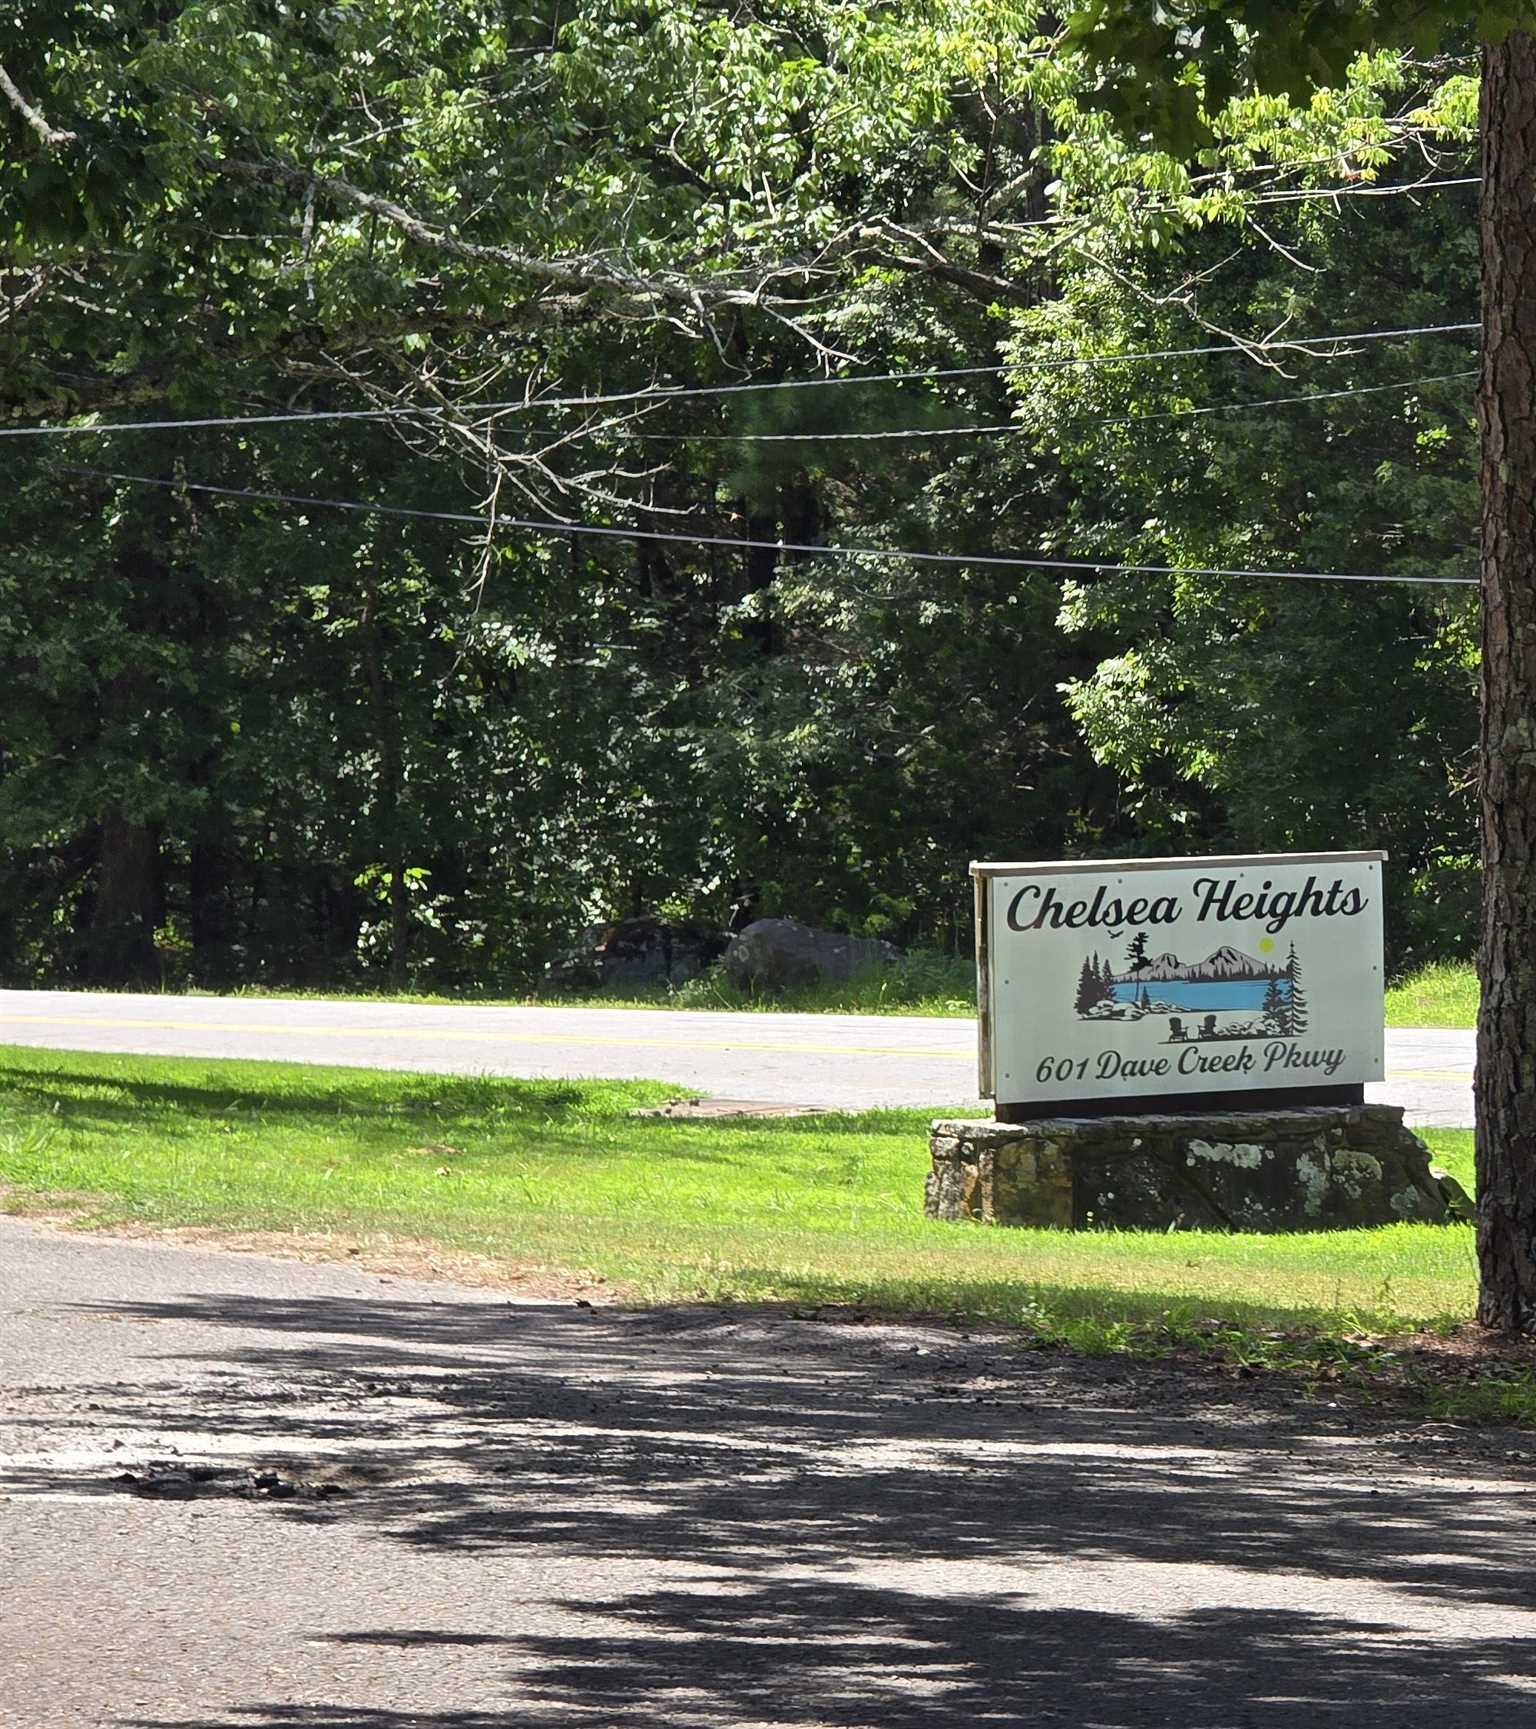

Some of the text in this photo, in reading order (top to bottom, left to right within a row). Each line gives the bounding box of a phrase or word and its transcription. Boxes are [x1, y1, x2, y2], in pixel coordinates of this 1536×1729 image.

[1006, 875, 1369, 934] Chelsea Heights
[1035, 1041, 1345, 1083] 601 Dave Creek Pkwy
